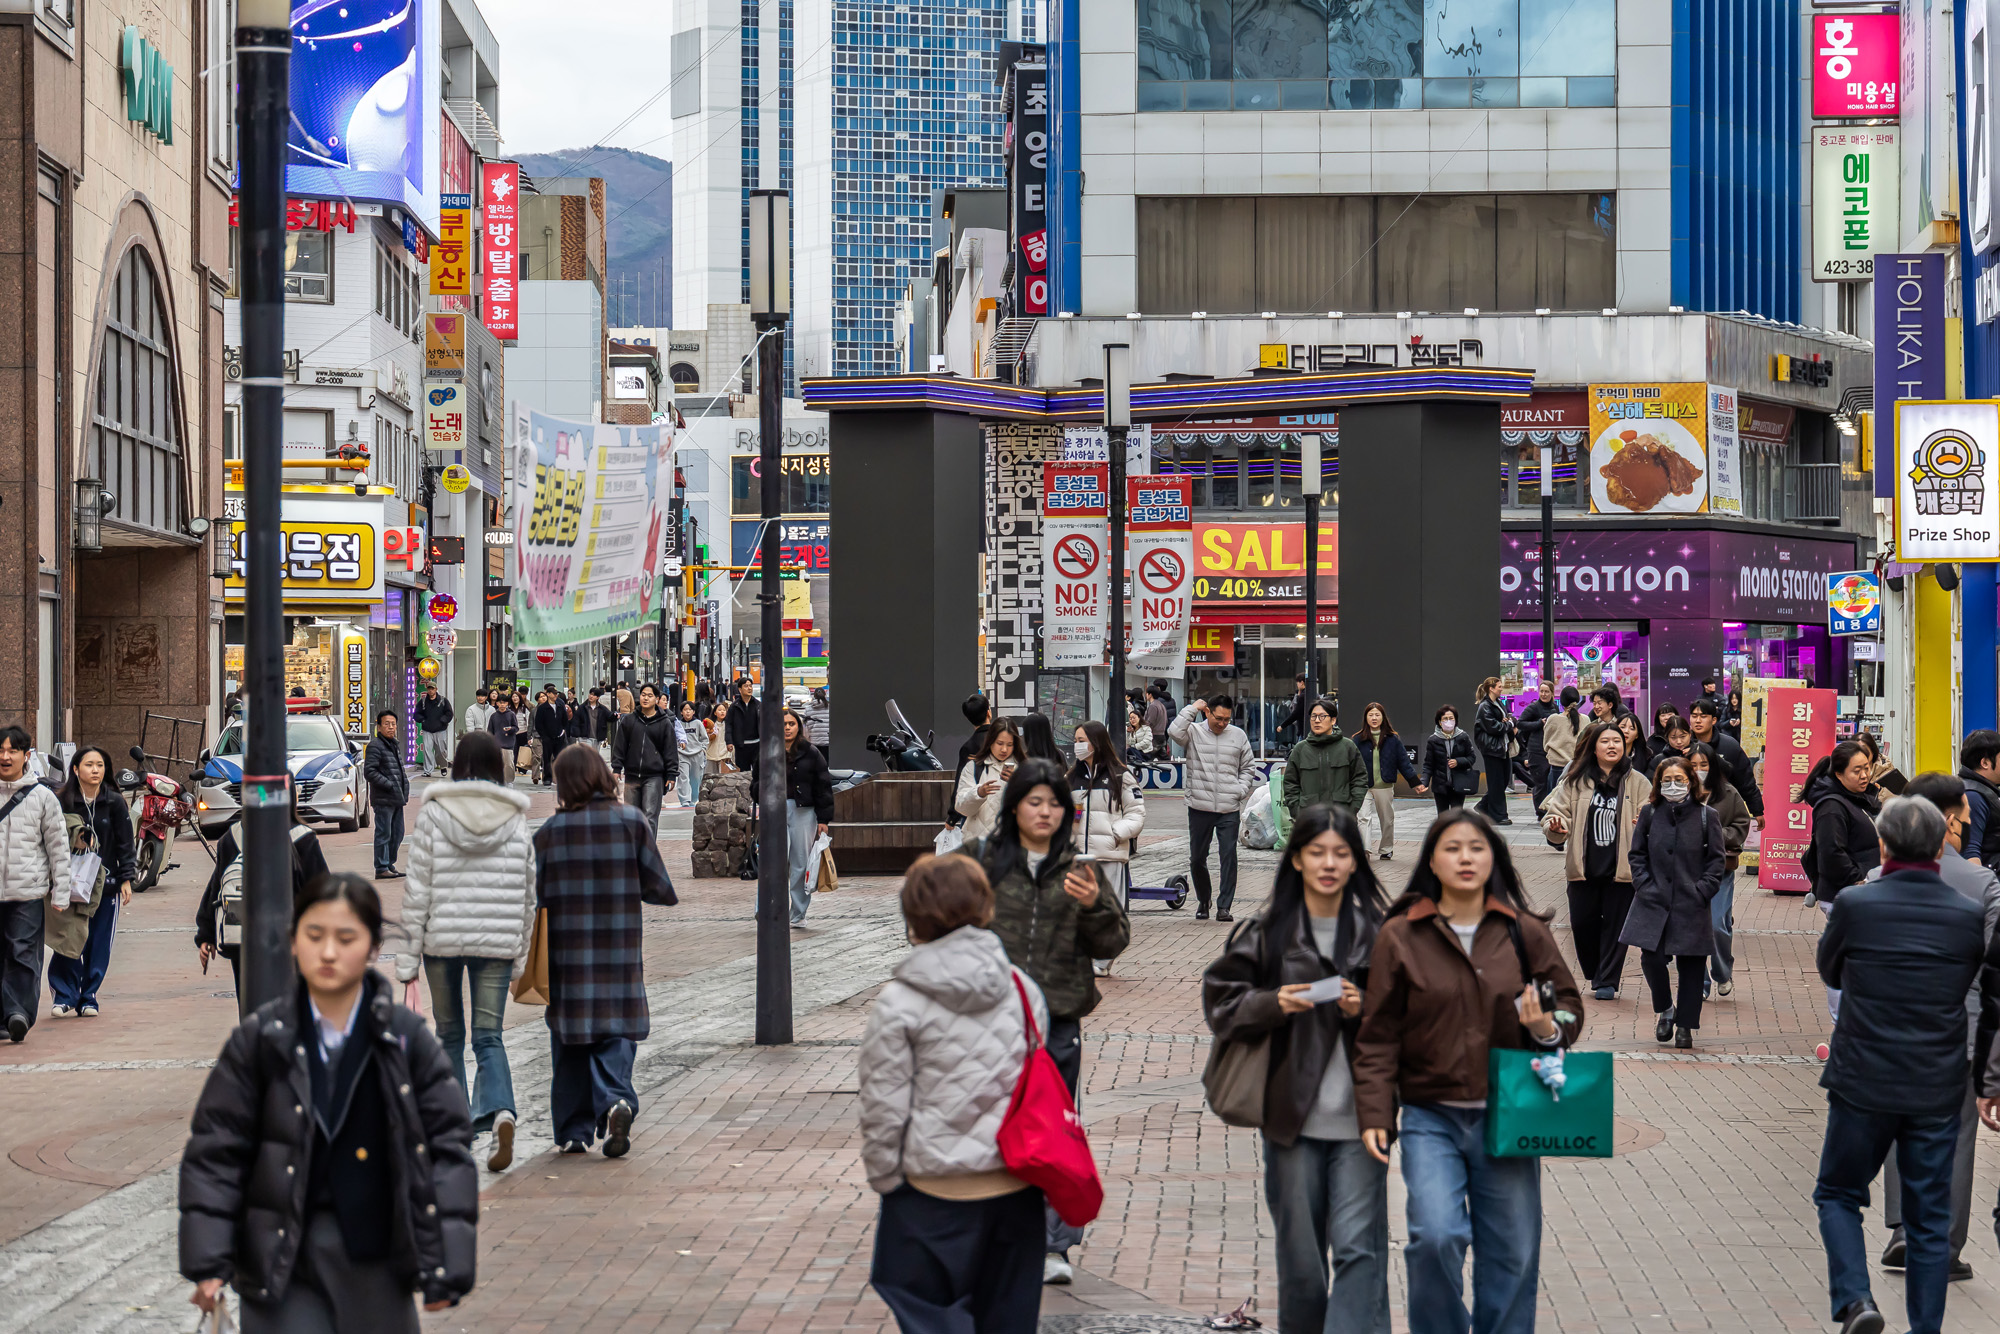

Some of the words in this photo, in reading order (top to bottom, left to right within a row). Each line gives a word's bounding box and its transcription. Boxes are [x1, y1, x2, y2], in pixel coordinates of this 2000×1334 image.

[1820, 19, 1858, 80] 홍
[1847, 81, 1896, 103] 미용실
[1820, 135, 1847, 145] 중고폰
[1843, 153, 1870, 250] 에코폰
[438, 214, 466, 290] 부동산
[488, 223, 514, 302] 방탈출
[492, 306, 510, 320] 3F
[1897, 259, 1922, 369] HOLIKA
[427, 348, 464, 359] 성형외과
[431, 392, 444, 405] 짱
[446, 389, 454, 400] 2
[1596, 387, 1629, 399] 추억의
[1631, 388, 1660, 398] 1980
[1607, 402, 1698, 419] 심해돈까스
[429, 413, 462, 431] 노래
[433, 431, 462, 442] 연습장
[1075, 438, 1092, 447] 경기
[1054, 475, 1098, 491] 동성로
[1047, 492, 1105, 508] 금연거리
[1138, 489, 1182, 506] 동성로
[1131, 506, 1189, 523] 금연거리
[1909, 528, 1947, 541] Prize
[1953, 528, 1991, 543] Shop
[384, 528, 419, 570] 약
[1201, 528, 1333, 570] SALE
[1055, 583, 1098, 605] NO!
[1268, 586, 1302, 597] SALE
[432, 602, 455, 616] 노래
[1055, 606, 1098, 616] SMOKE
[1142, 597, 1184, 619] NO!
[1777, 607, 1793, 615] ARCADE
[1058, 626, 1074, 634] 흡연시
[1142, 620, 1182, 631] SMOKE
[1834, 618, 1878, 631] 미용실
[428, 633, 455, 646] 부동산
[1517, 1136, 1597, 1149] OSULLOC
